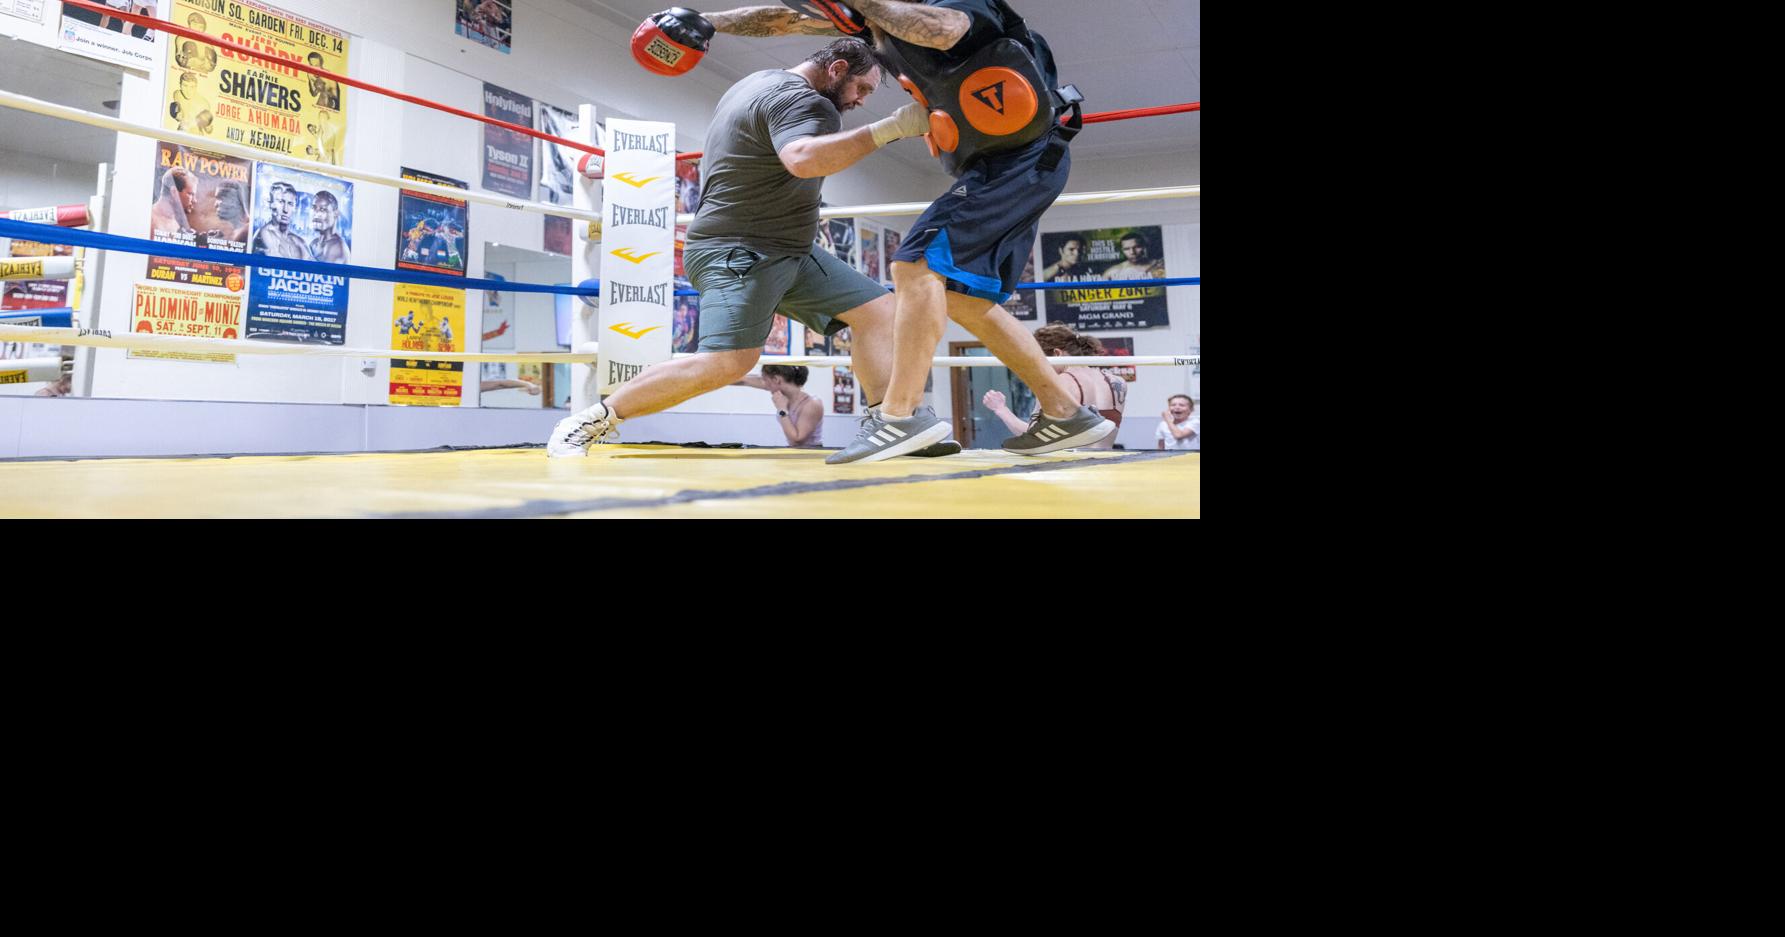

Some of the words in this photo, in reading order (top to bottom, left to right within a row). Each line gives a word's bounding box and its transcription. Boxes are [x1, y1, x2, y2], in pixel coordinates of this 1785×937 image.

[183, 0, 225, 14] DISON
[229, 3, 245, 22] SQ.
[249, 10, 285, 34] GARDEN
[290, 24, 305, 41] FRI.
[309, 29, 328, 49] DEC.
[332, 38, 343, 53] 14
[250, 35, 279, 47] JERRY
[247, 69, 278, 83] EARNIE
[219, 69, 301, 112] SHAVERS
[485, 90, 531, 118] Holyfield
[216, 102, 241, 120] JORGE
[248, 108, 300, 134] AHUMADA
[226, 126, 245, 142] ANDY
[249, 129, 292, 154] KENDALL
[613, 129, 670, 155] EVERLAST
[160, 148, 198, 172] RAW
[200, 157, 248, 182] POWER
[486, 144, 518, 164] Tyson
[611, 203, 669, 230] EVERLAST
[151, 268, 176, 280] DURAN
[191, 274, 223, 286] MARTINEZ
[267, 278, 334, 297] JACOBS
[609, 280, 668, 306] EVERLAST
[1060, 288, 1113, 302] DANGER
[135, 293, 198, 321] PALOMINO
[204, 301, 241, 325] MUNIZ
[1101, 312, 1134, 320] GRAND
[186, 323, 212, 335] SEPT.
[608, 360, 645, 386] EVER
